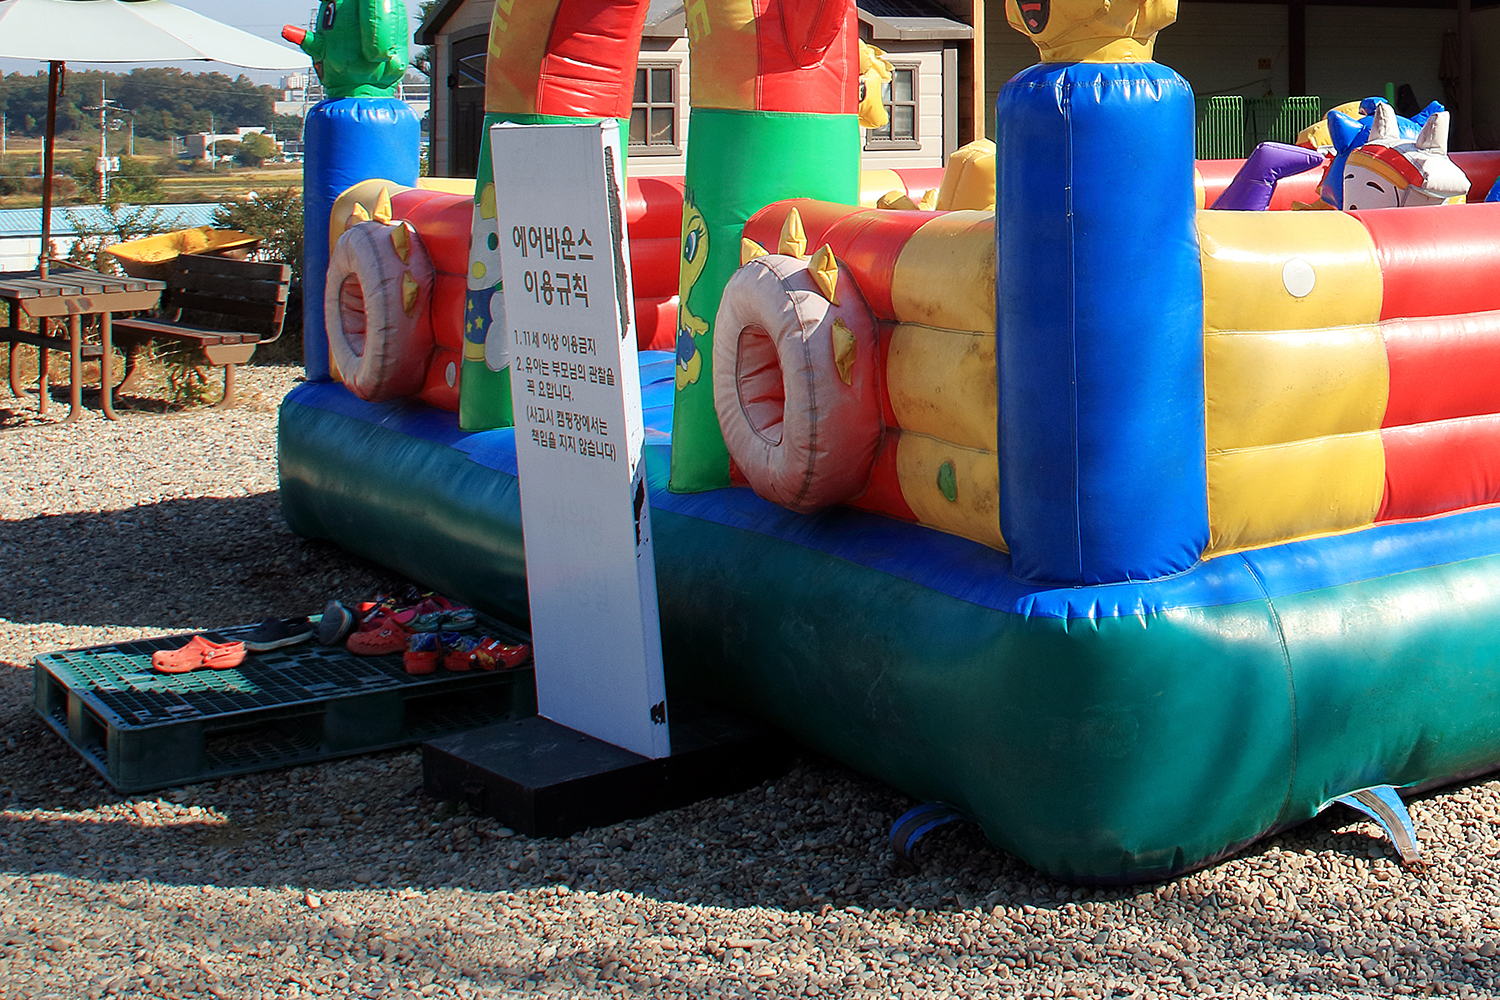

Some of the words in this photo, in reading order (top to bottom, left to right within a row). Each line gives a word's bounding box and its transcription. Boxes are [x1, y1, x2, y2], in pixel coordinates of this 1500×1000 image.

[512, 225, 594, 261] 에어바운스
[524, 269, 589, 308] 이용규칙
[542, 332, 560, 351] 이상
[562, 334, 597, 356] 이용금지
[552, 360, 587, 382] 부모님의
[588, 366, 615, 386] 관찰을
[526, 379, 536, 396] 꼭
[538, 380, 575, 402] 요합니다.
[526, 404, 555, 426] (사고시
[556, 410, 608, 436] 캠핑장에서는
[531, 428, 557, 449] 책임을
[559, 434, 577, 453] 지지
[578, 437, 617, 463] 않습니다)
